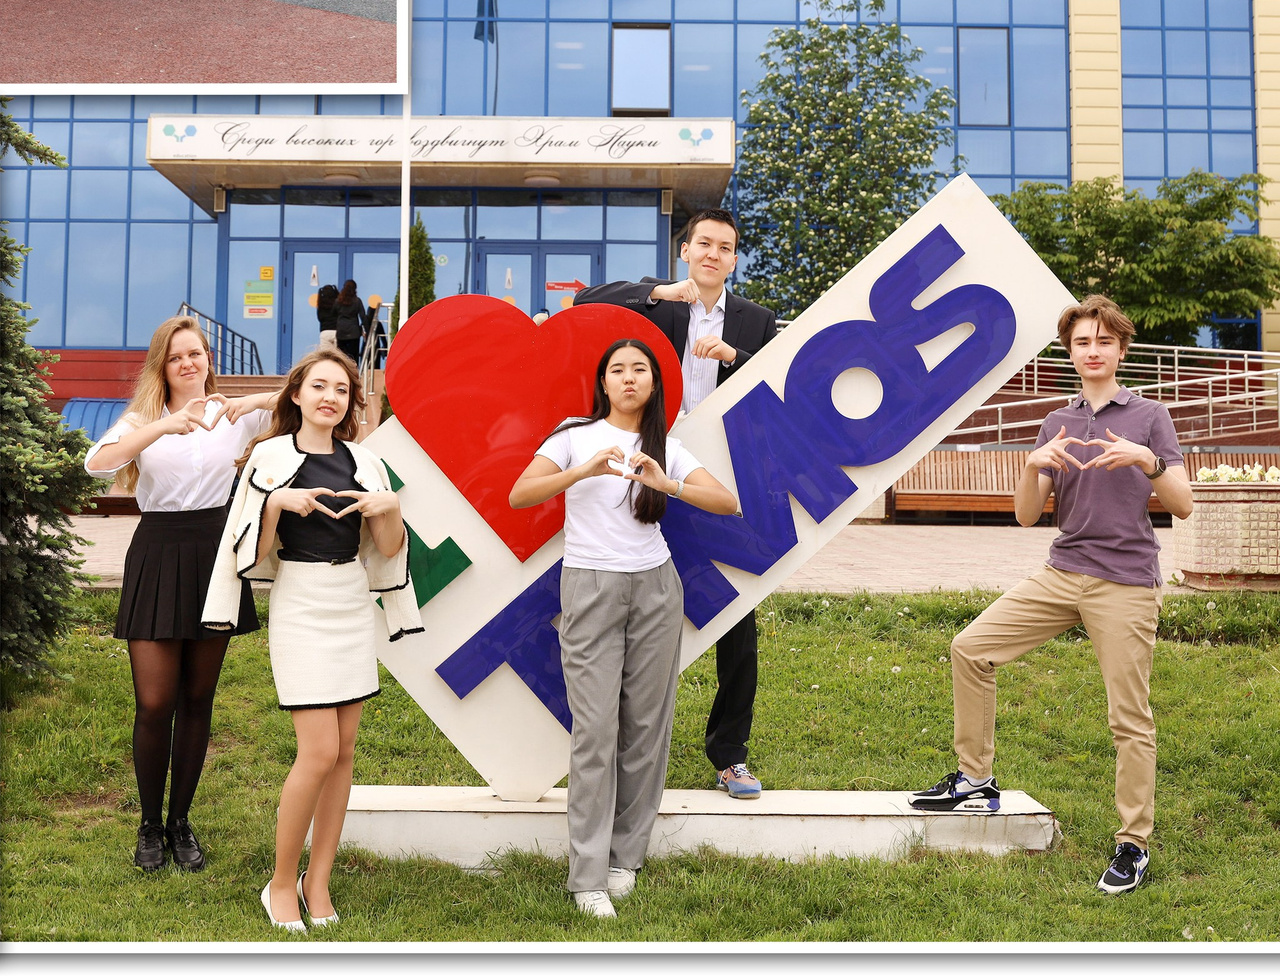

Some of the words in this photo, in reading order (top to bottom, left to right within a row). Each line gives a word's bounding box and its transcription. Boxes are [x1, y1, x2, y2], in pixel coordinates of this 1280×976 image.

[214, 121, 278, 156] Среди
[285, 124, 360, 147] высоких
[368, 133, 397, 154] гор
[515, 125, 581, 155] Храм
[587, 124, 662, 160] Науки
[435, 224, 1017, 736] TMOS
